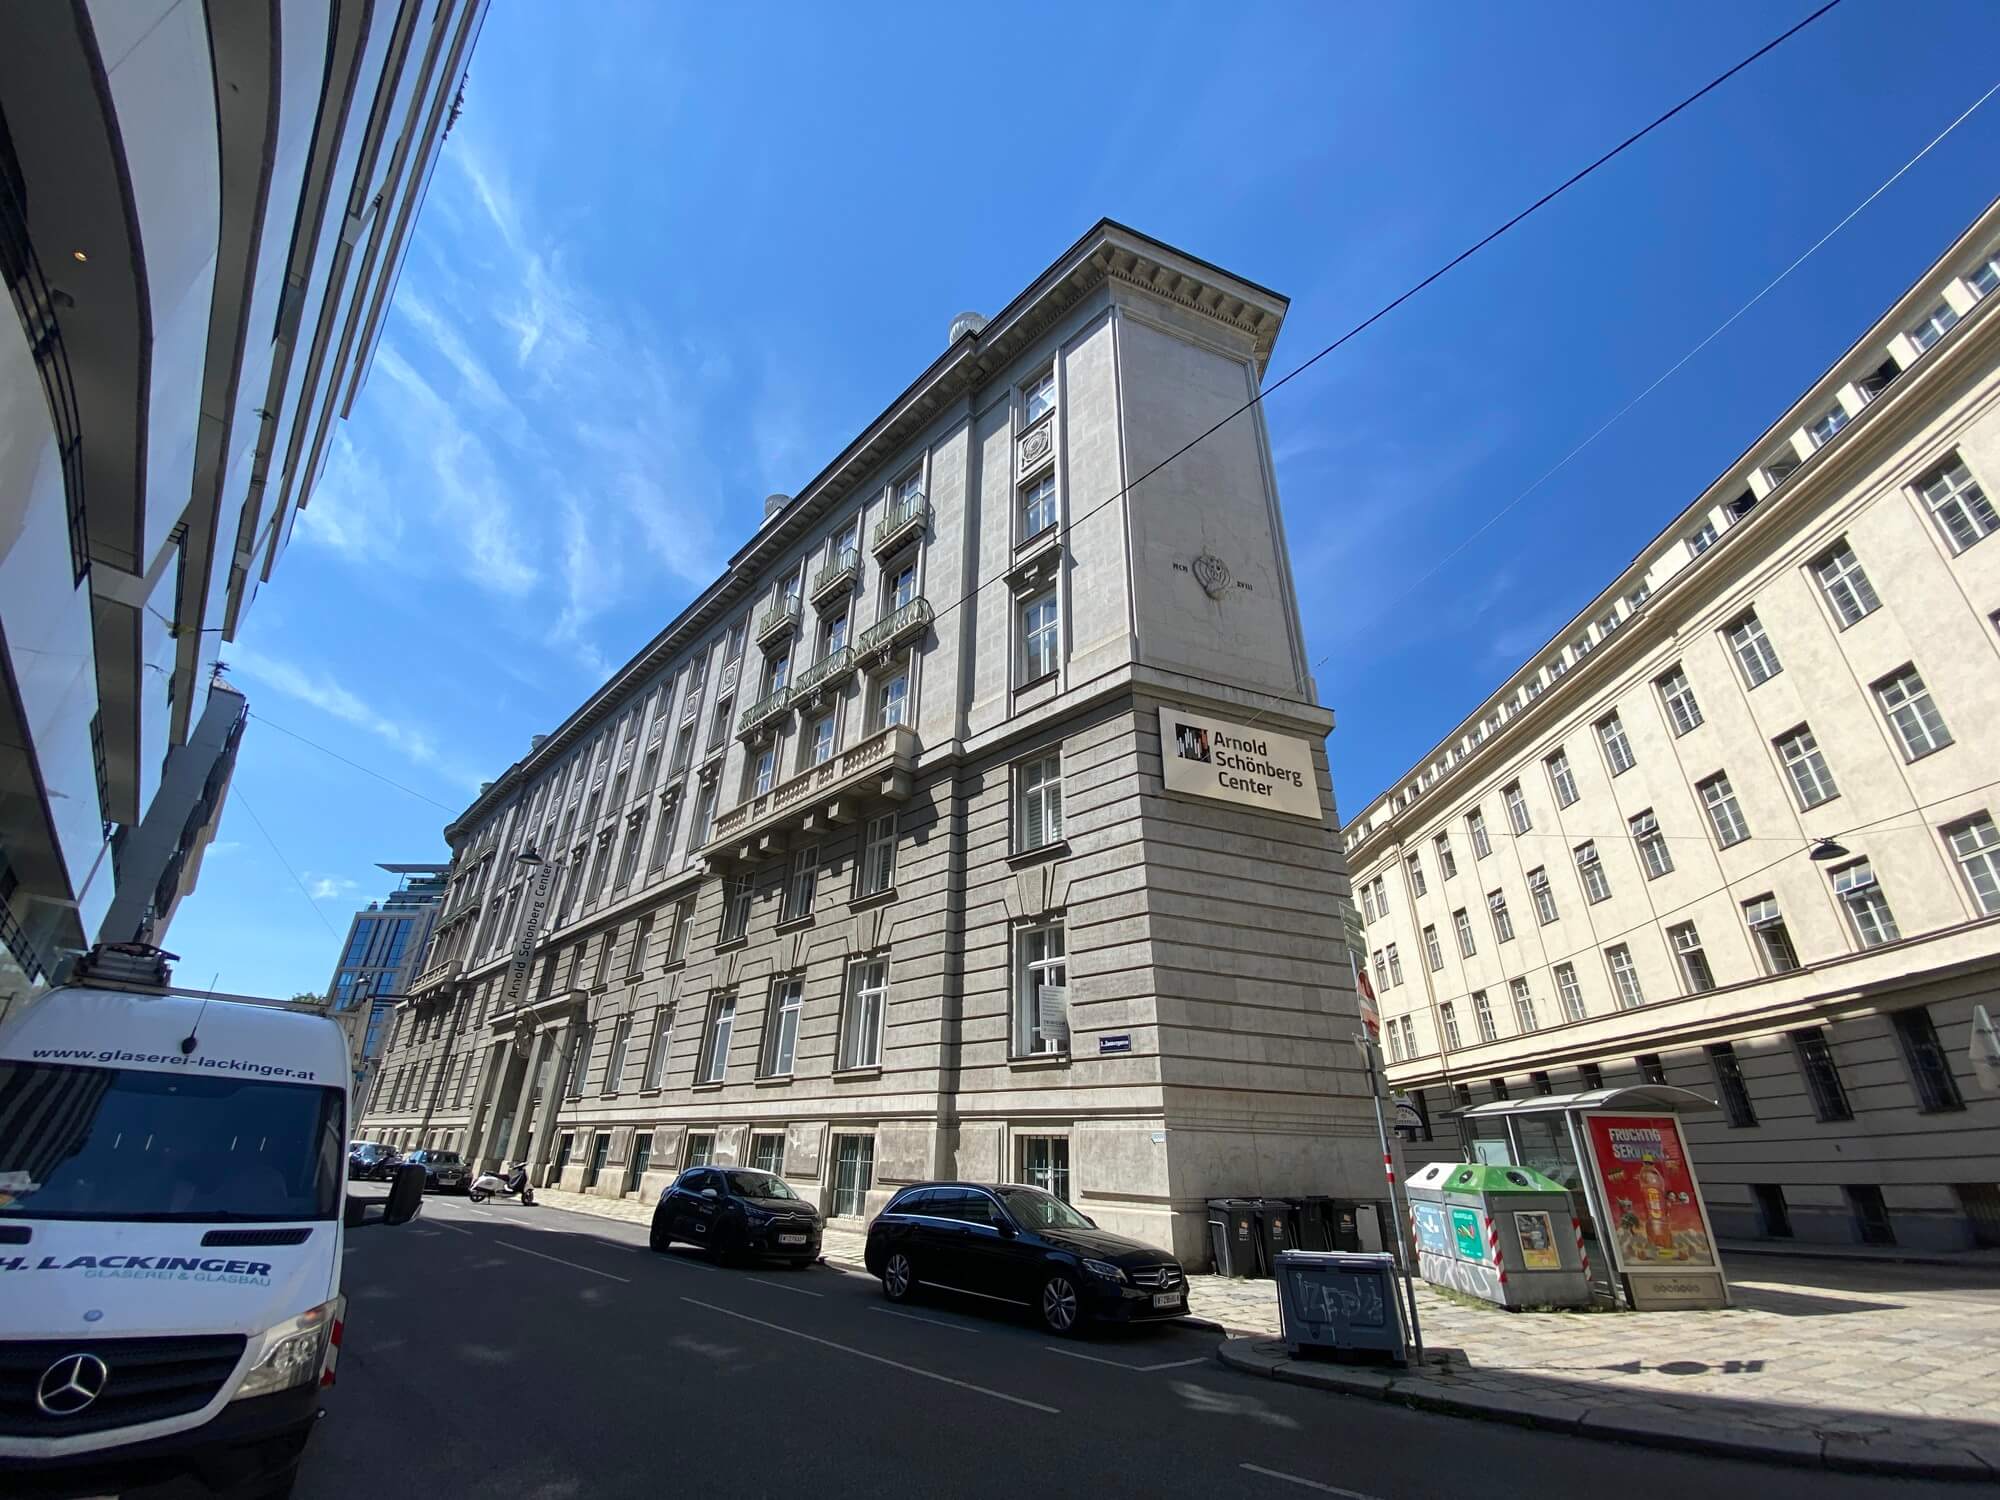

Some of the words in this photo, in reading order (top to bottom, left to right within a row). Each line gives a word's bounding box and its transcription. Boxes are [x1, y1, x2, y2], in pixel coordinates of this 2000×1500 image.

[1214, 731, 1267, 757] Arnold
[1215, 751, 1303, 787] Schönberg
[1218, 771, 1273, 796] Center
[508, 961, 526, 999] Arnold
[535, 864, 553, 897] Center
[32, 1049, 315, 1081] www.glaserei-lackinger.at
[1608, 1127, 1662, 1142] FRUCHTIG
[36, 1255, 272, 1276] LACKINGER
[84, 1269, 174, 1280] GLASEREI
[177, 1271, 190, 1281] &
[193, 1271, 272, 1287] GLASBAU
